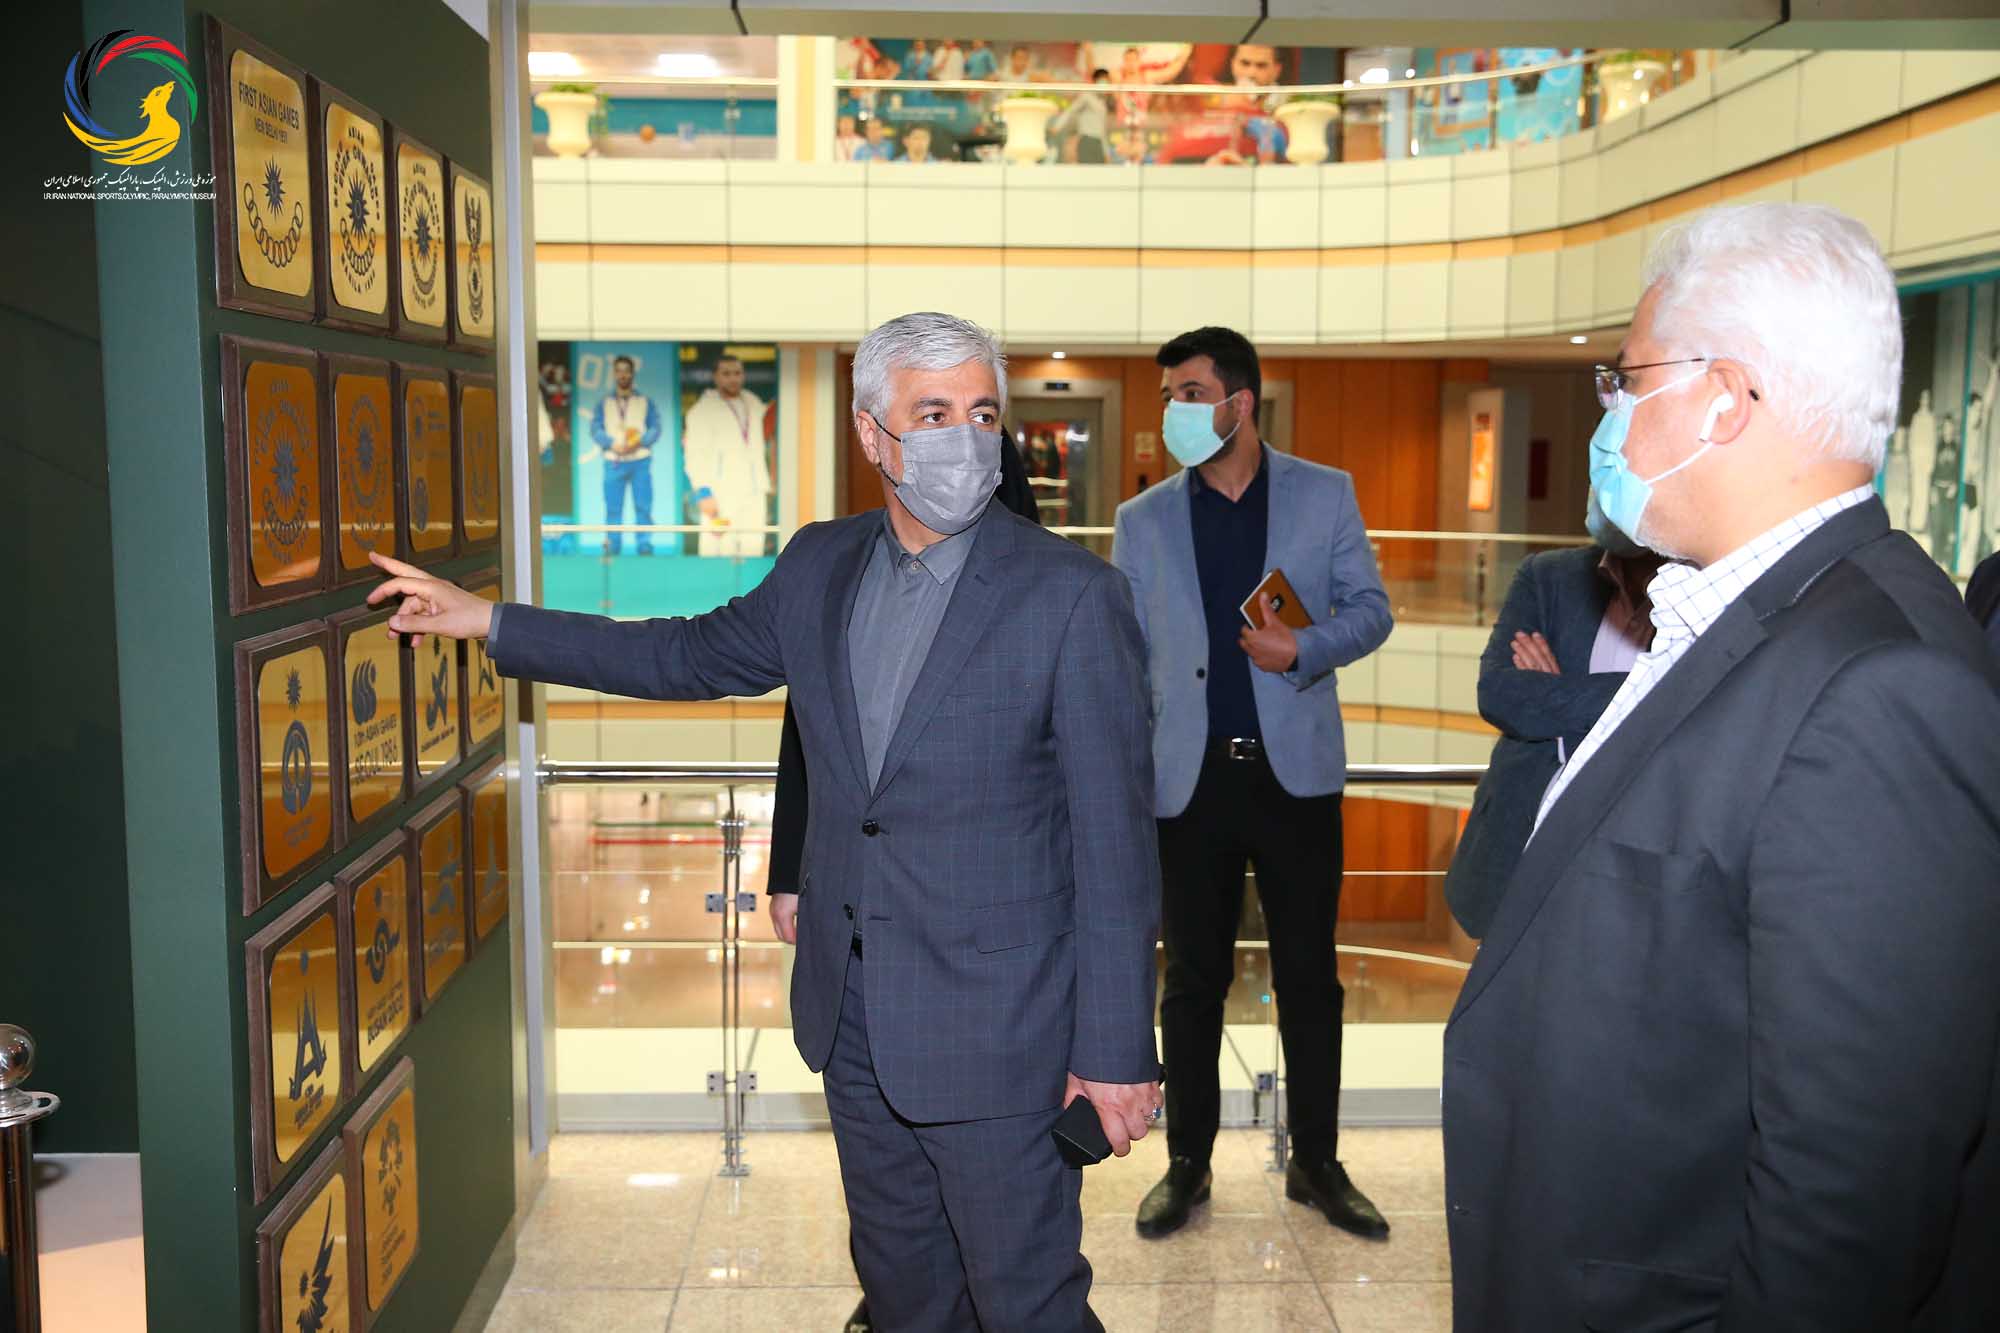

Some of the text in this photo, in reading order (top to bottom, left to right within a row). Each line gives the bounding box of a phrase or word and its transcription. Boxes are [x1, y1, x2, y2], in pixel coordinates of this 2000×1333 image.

[238, 81, 299, 131] FIRST ASIAN GAMES
